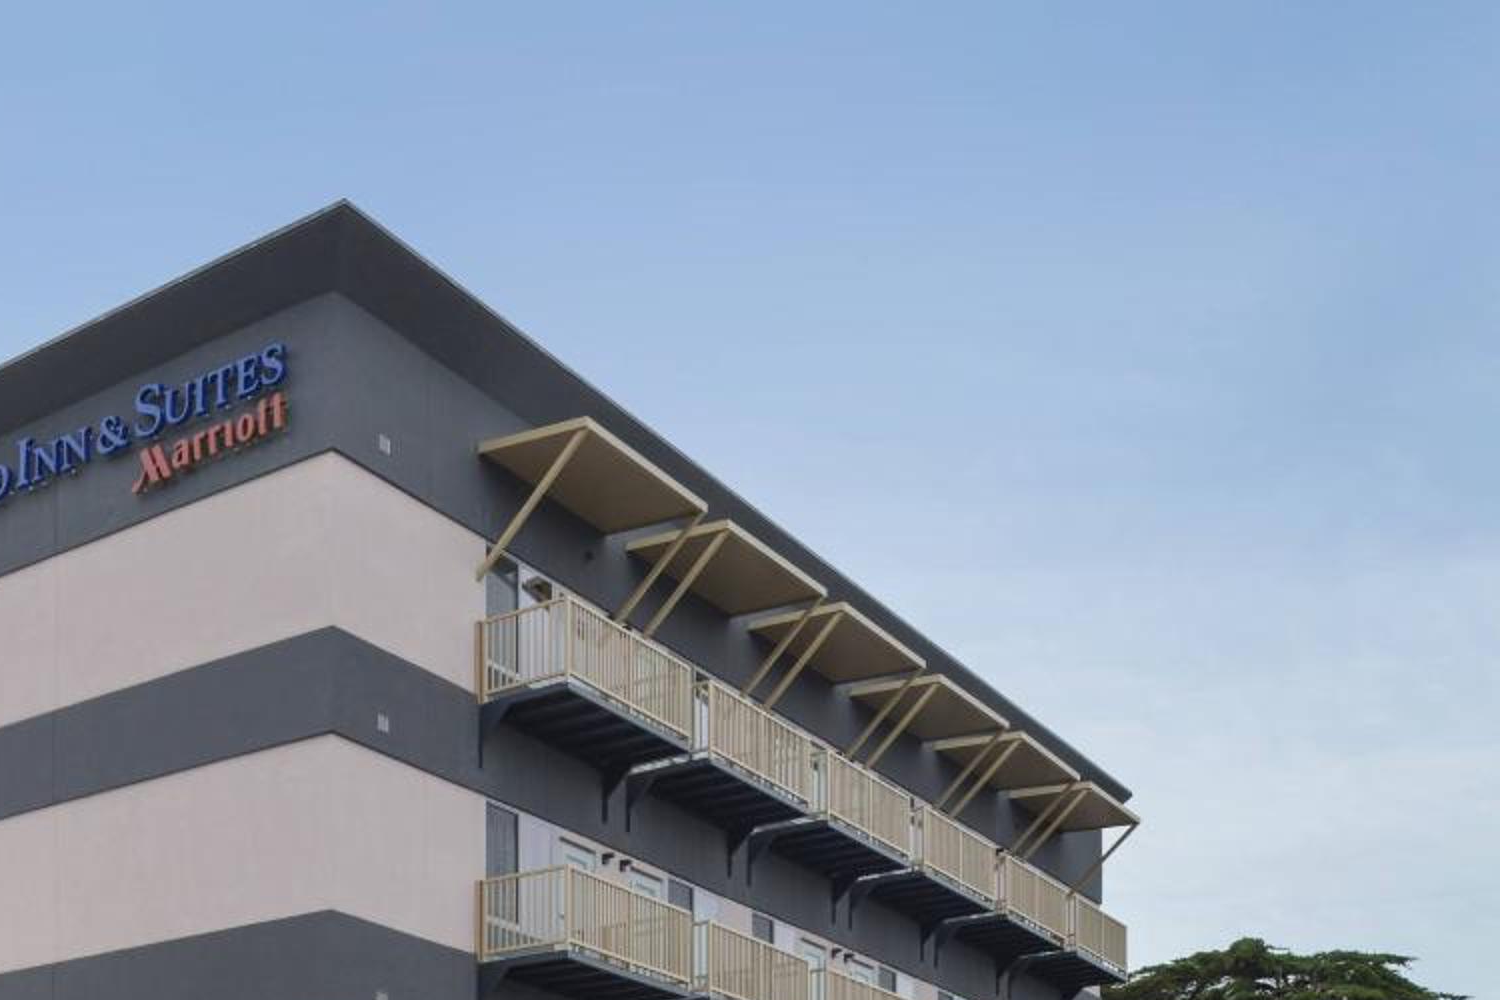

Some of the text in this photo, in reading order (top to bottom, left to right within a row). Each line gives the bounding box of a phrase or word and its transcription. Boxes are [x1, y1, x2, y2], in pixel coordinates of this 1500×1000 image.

[15, 426, 94, 491] INN
[97, 415, 129, 455] &
[134, 342, 288, 438] SUITES
[131, 392, 287, 494] Marriott
